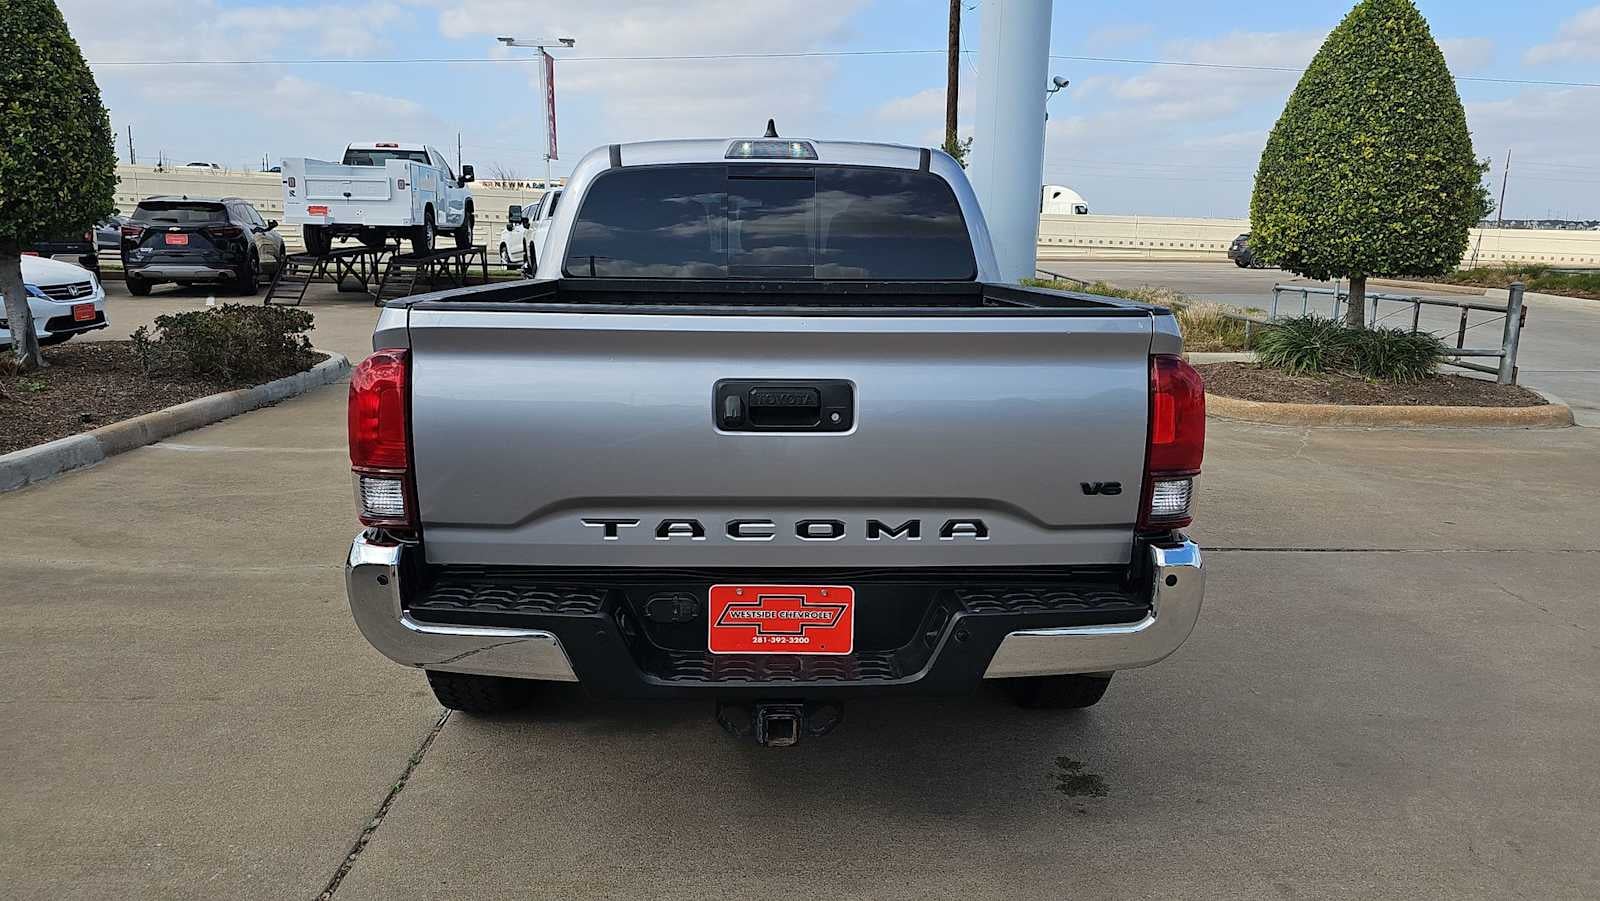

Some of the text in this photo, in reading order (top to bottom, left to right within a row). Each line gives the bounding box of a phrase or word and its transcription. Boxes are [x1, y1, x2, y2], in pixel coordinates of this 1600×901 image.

[754, 392, 816, 406] TOYOTA
[1080, 482, 1122, 496] V6
[581, 519, 990, 541] TACOMA
[730, 610, 833, 619] WESTSIDE CHEVROLET
